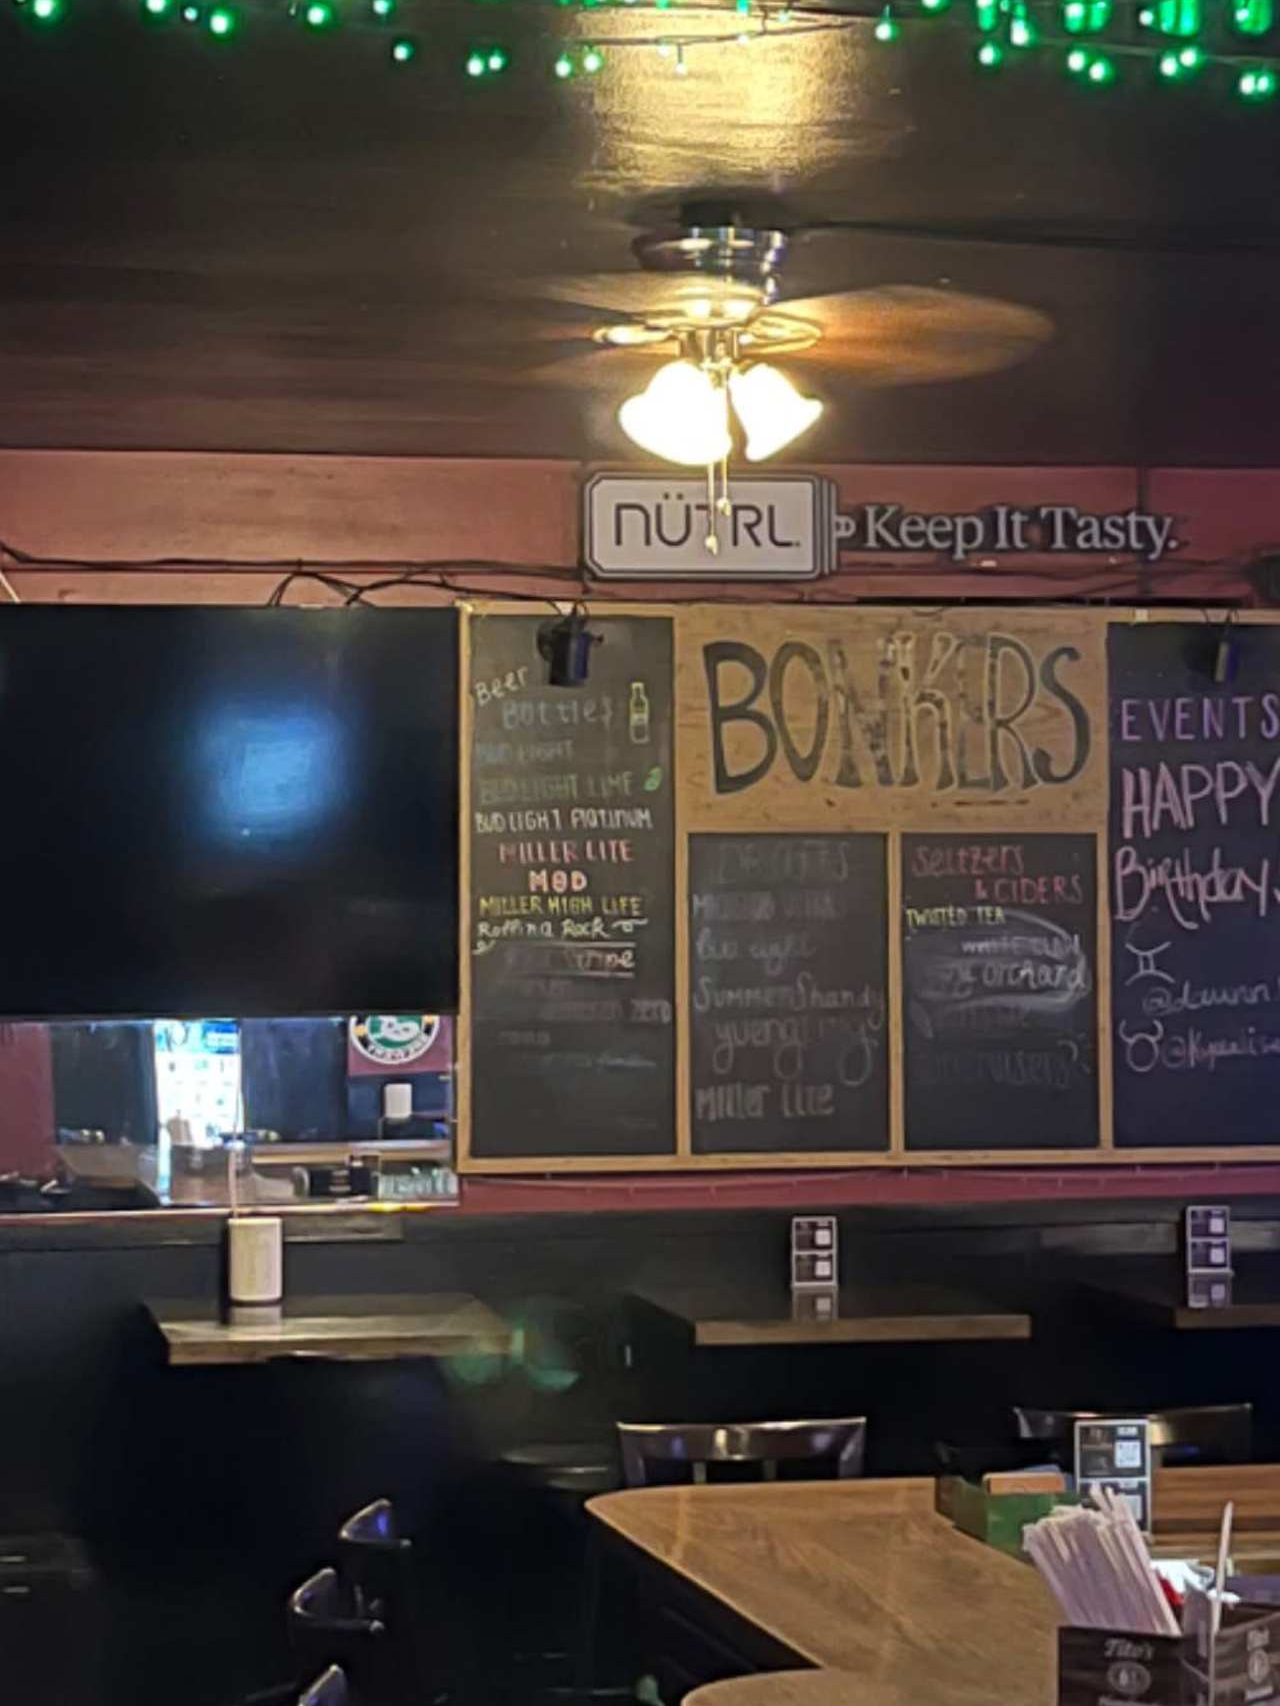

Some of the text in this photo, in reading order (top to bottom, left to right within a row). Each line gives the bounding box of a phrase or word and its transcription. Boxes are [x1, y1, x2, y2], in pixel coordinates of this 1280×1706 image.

[865, 504, 1180, 560] Keep It Tasty.
[1121, 693, 1280, 742] EVENTS
[499, 839, 634, 864] MILLER LITE
[478, 895, 643, 917] MILLER HIGH LIFE
